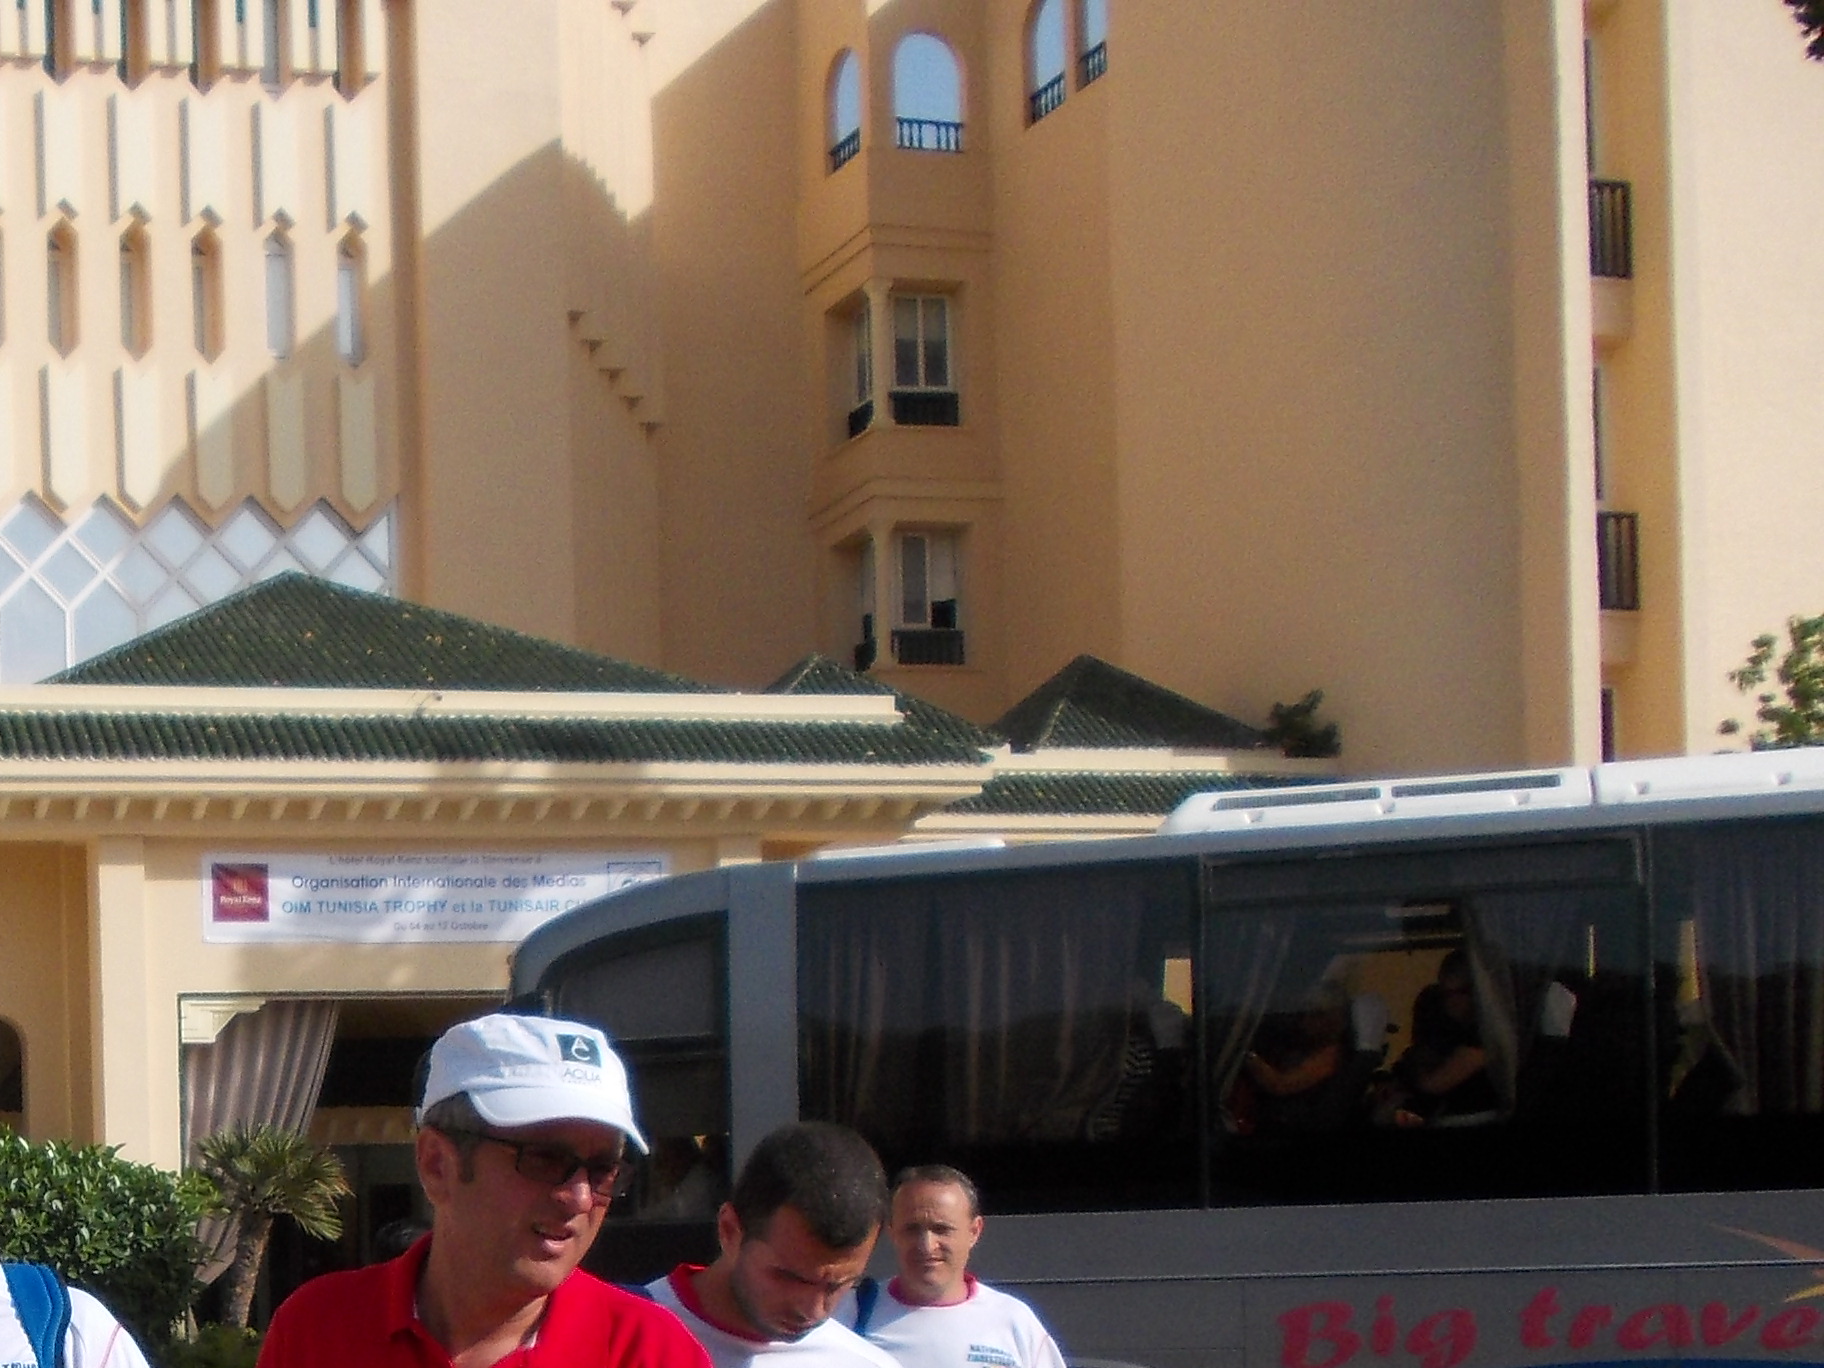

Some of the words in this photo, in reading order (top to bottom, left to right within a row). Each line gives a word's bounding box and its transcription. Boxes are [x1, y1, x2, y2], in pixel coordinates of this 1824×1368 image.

[292, 874, 388, 892] Organisation
[393, 874, 497, 889] Internationale
[502, 874, 527, 889] des
[281, 900, 311, 914] OIM
[317, 900, 379, 914] TUNISIA
[384, 900, 448, 914] TROPHY
[452, 900, 466, 913] et
[470, 900, 483, 913] la
[489, 900, 560, 913] TUNISAIR
[1518, 1286, 1823, 1351] trave
